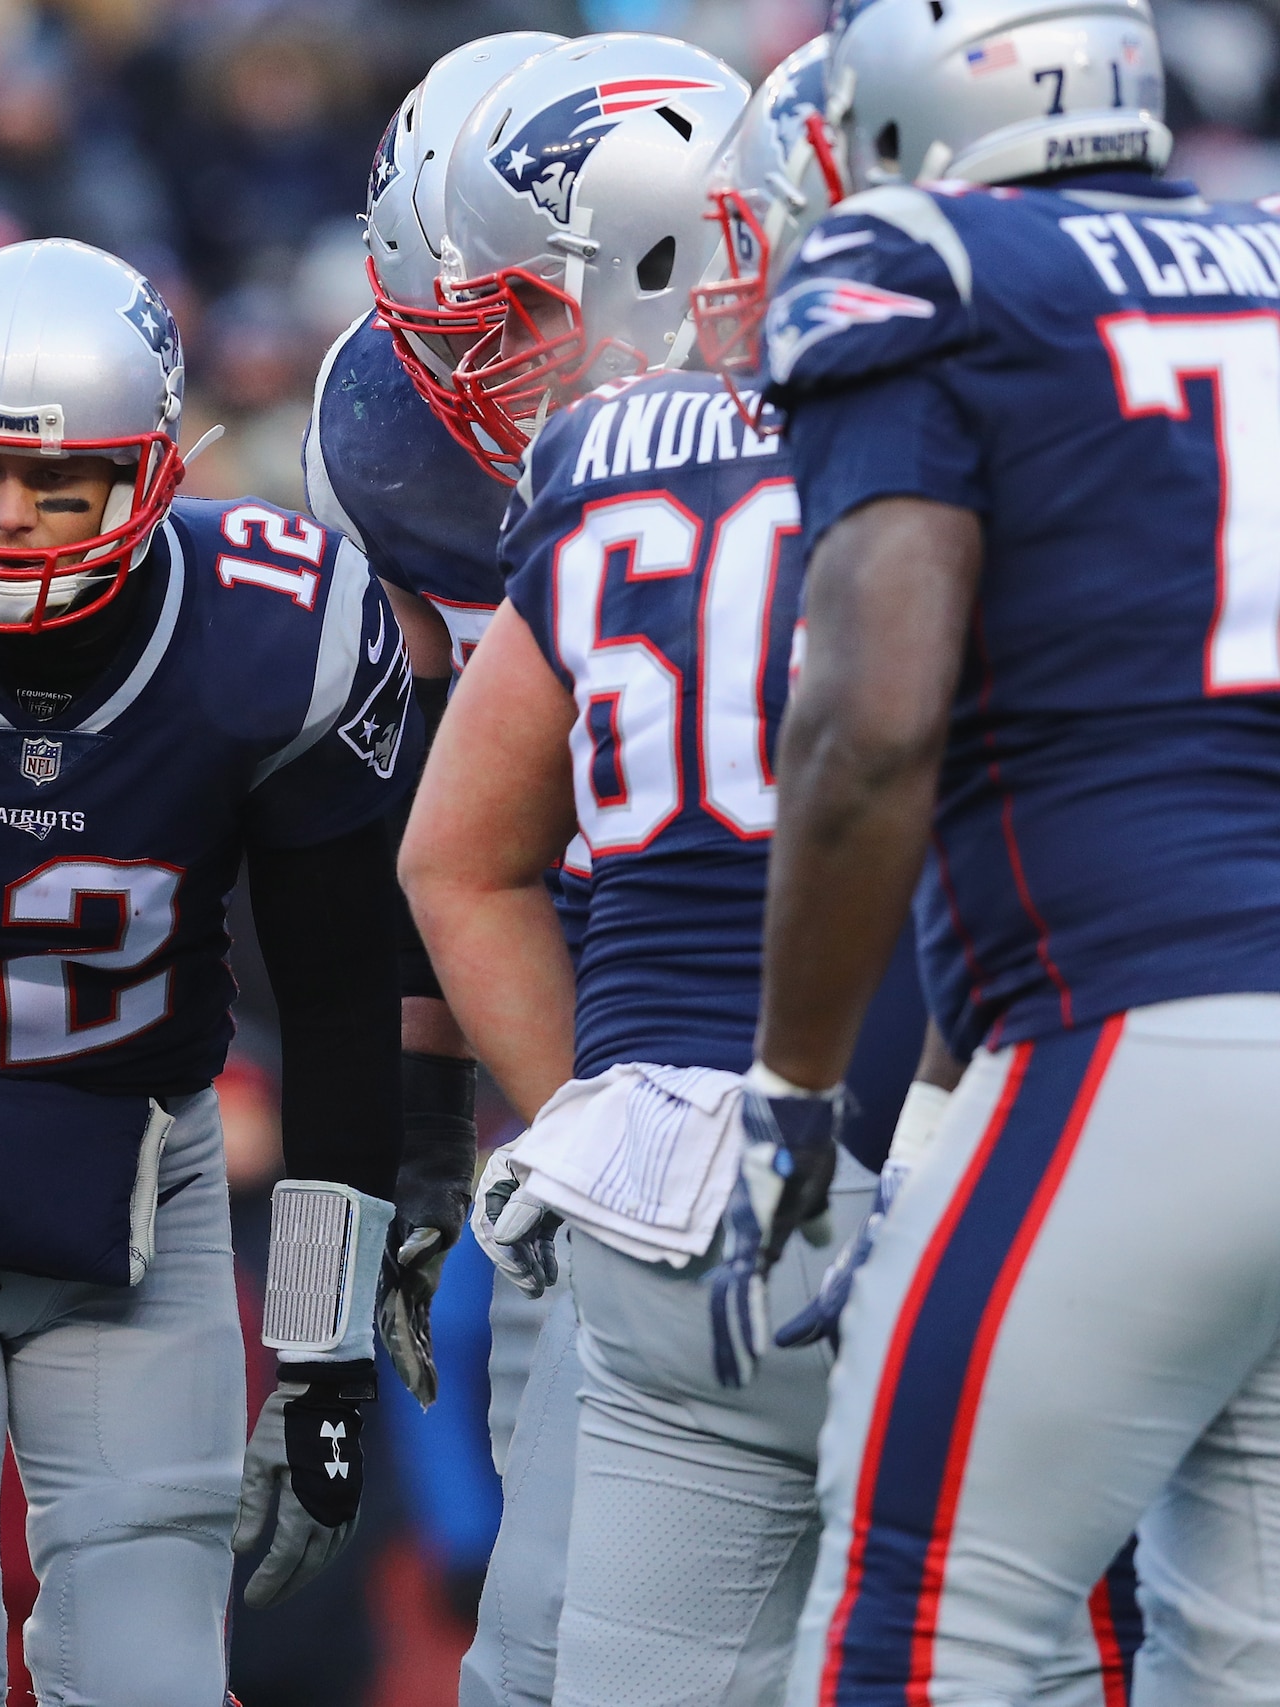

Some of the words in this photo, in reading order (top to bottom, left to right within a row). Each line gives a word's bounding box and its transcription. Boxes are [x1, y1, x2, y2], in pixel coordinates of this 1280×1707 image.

[1058, 212, 1280, 299] FLEMI
[215, 503, 327, 613] 12
[552, 476, 803, 861] 60
[27, 756, 54, 776] NFL
